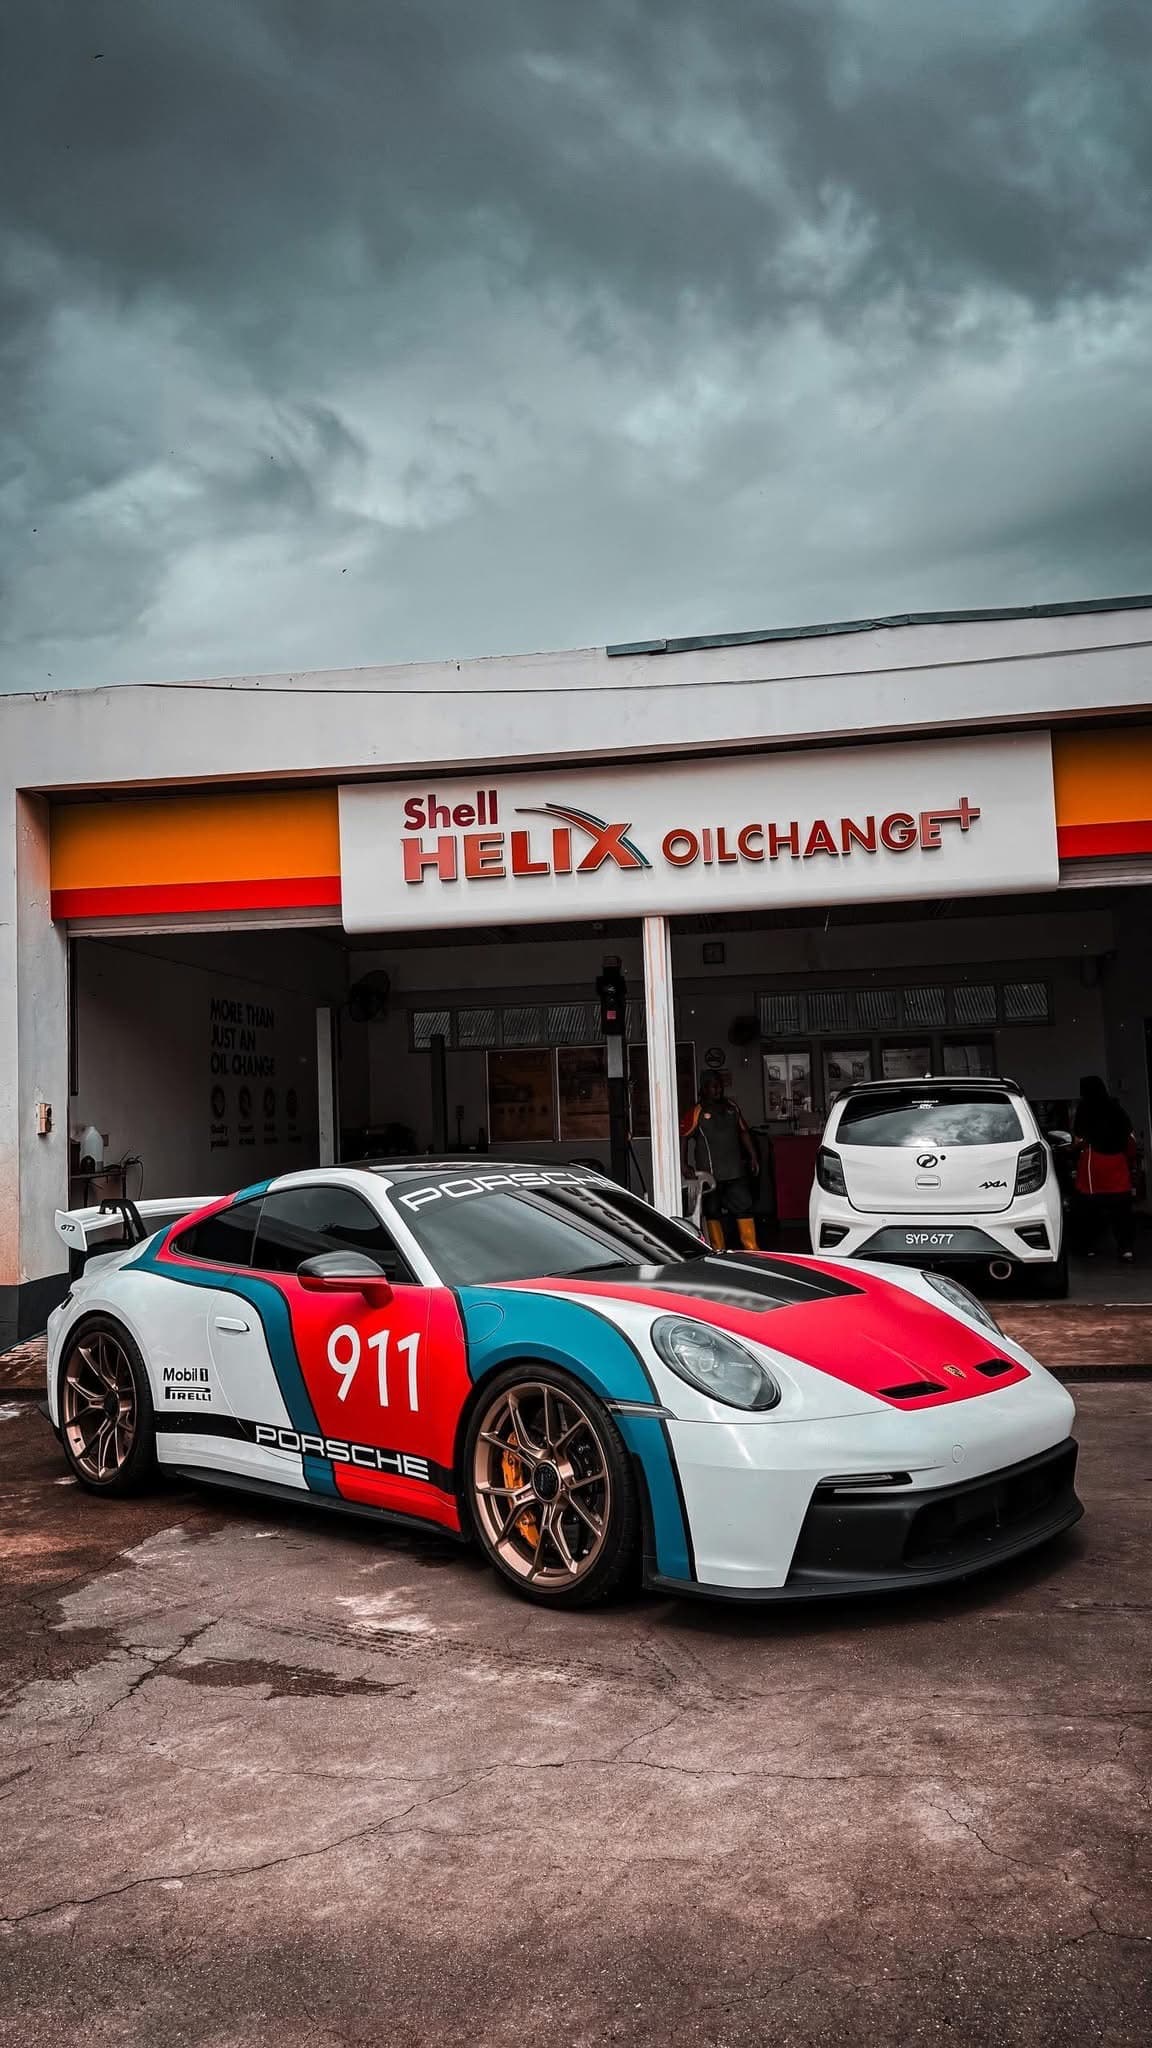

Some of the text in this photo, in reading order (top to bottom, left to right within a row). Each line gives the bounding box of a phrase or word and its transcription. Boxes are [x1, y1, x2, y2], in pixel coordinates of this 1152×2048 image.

[403, 789, 498, 831] Shell
[400, 803, 652, 883] HELIX
[209, 998, 275, 1029] MORE THAN
[211, 1024, 256, 1051] JUST AN
[210, 1053, 276, 1078] OIL CHANGE
[979, 1180, 1008, 1190] AXIA
[61, 1224, 75, 1232] GT3
[905, 1233, 954, 1245] SYP 677
[163, 1367, 198, 1382] Mobil
[327, 1324, 420, 1412] 911
[165, 1386, 212, 1401] PIRELLI
[255, 1424, 430, 1481] PORSCHE
